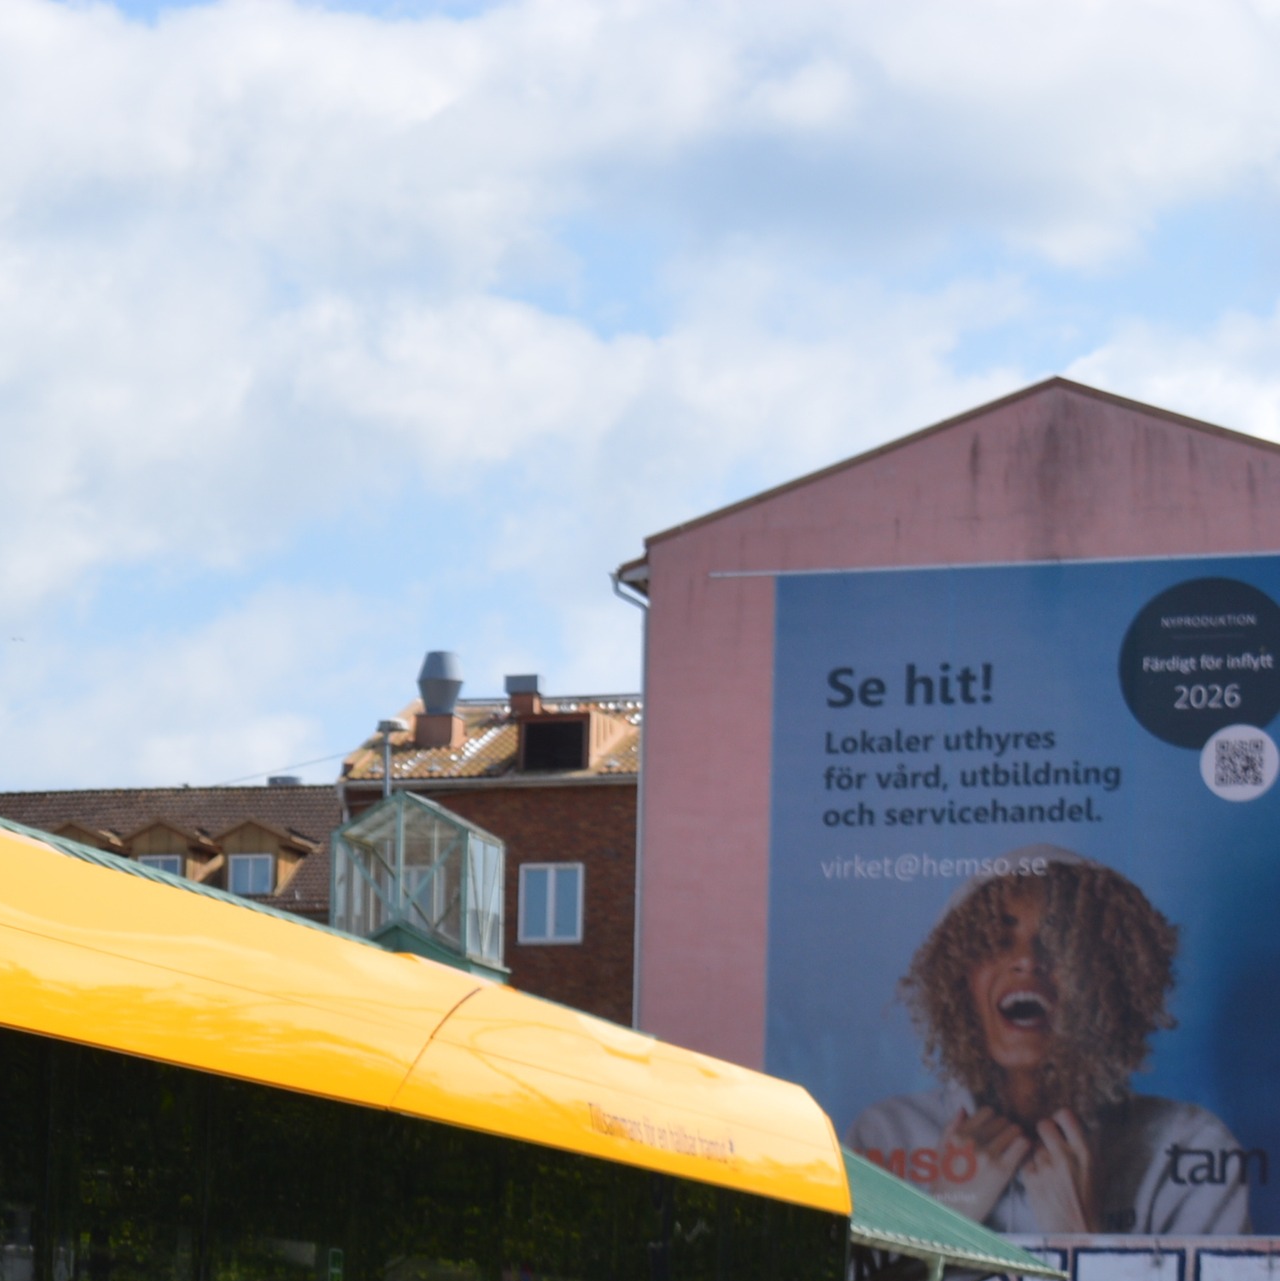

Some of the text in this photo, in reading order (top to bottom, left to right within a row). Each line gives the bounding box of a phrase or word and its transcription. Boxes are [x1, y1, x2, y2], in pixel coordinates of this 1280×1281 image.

[1142, 651, 1274, 675] Färdigt för inflytt
[826, 663, 995, 709] Se hit!
[1173, 683, 1242, 710] 2026
[825, 727, 1056, 757] Lokaler uthyres
[824, 761, 1122, 792] för vård, utbildning
[822, 799, 1103, 828] och servicehandel.
[820, 851, 1049, 881] virket@hemso.se
[1164, 1142, 1269, 1187] tam
